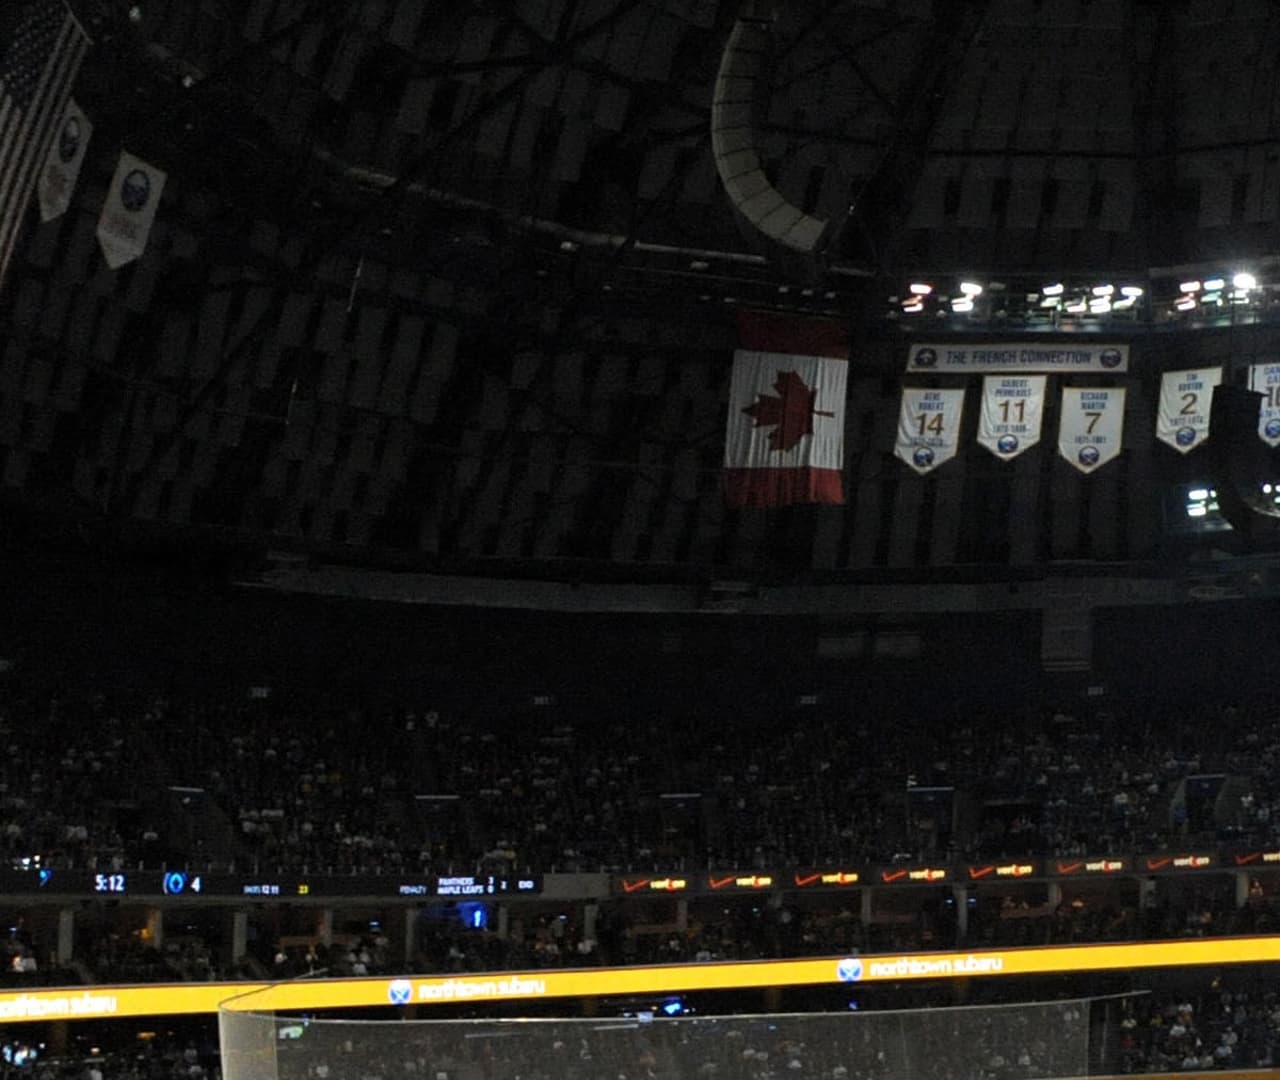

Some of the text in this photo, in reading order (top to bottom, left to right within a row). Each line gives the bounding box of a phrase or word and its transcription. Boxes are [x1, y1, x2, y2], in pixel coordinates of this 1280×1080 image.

[946, 350, 1093, 365] THE FRENCH CONNECTION
[997, 399, 1026, 424] 11
[1179, 392, 1199, 416] 2
[915, 412, 945, 436] 14
[1084, 412, 1103, 435] 7
[1086, 858, 1122, 873] verizon
[1173, 854, 1210, 868] verizon
[822, 870, 859, 886] verizon
[909, 868, 945, 883] verizon
[996, 863, 1033, 878] verizon
[95, 873, 201, 892] 5:12 4
[650, 877, 686, 894] verizon
[736, 874, 772, 889] verizon
[869, 955, 1003, 978] northtown subaru
[418, 976, 545, 1001] northtown subaru
